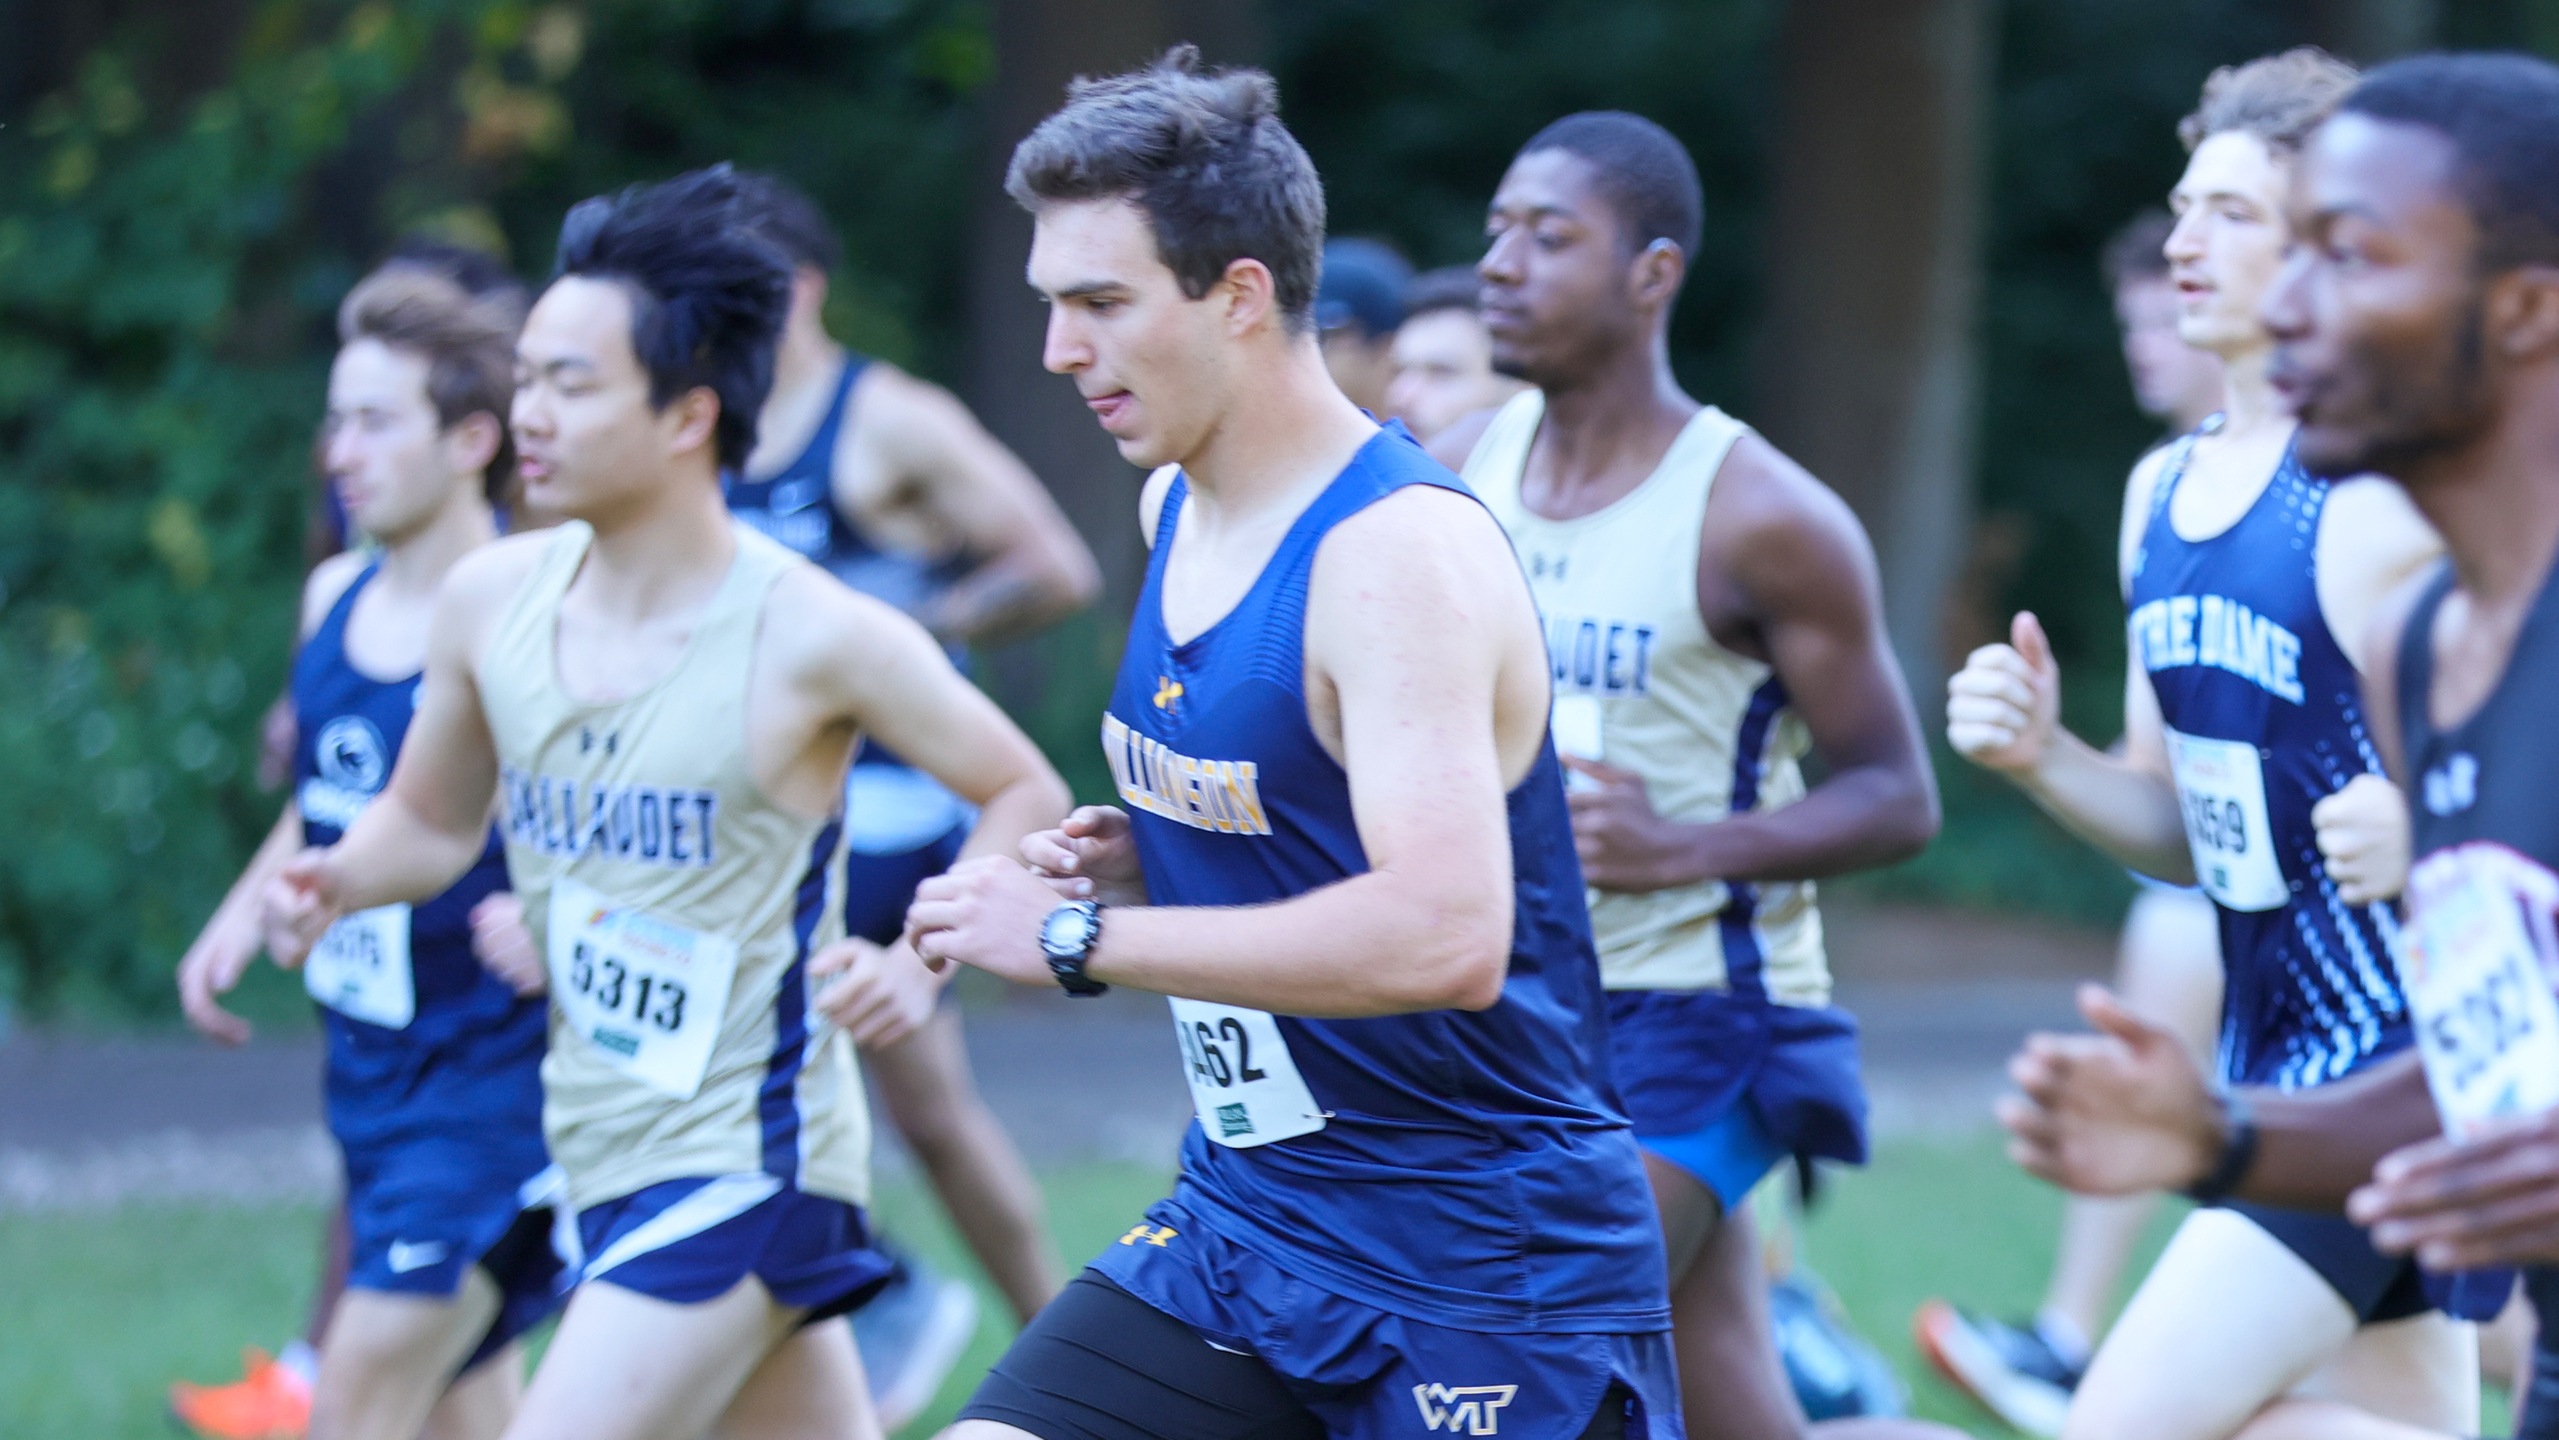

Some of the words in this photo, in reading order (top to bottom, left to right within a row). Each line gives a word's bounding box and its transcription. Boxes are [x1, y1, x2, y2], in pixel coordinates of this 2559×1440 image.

[2198, 594, 2306, 706] DAME
[571, 940, 688, 1033] 5313
[1412, 1383, 1519, 1436] WT
